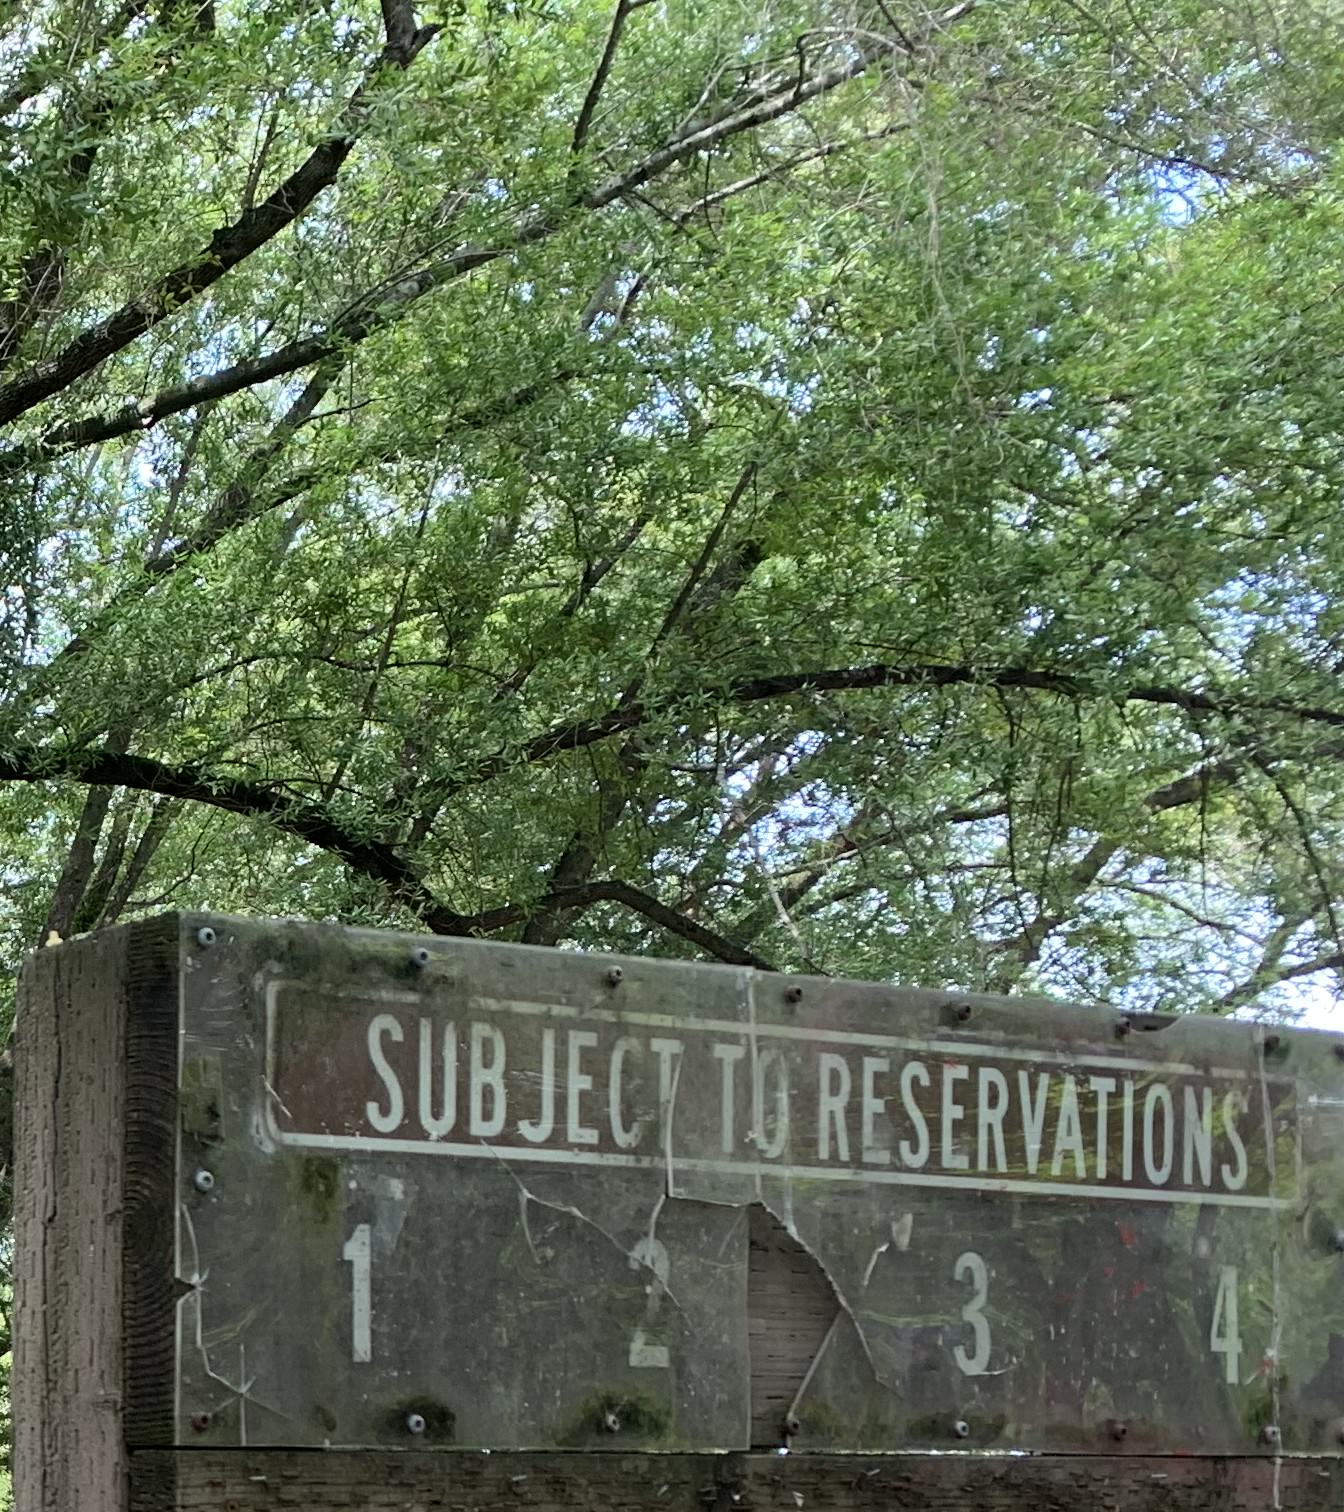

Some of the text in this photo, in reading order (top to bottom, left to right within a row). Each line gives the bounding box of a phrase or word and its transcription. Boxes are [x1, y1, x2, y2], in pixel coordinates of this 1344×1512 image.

[366, 1013, 1249, 1190] SUBJECT TO RESERVATIONS
[343, 1224, 371, 1362] 1
[953, 1251, 991, 1376] 3
[1211, 1265, 1242, 1384] 4
